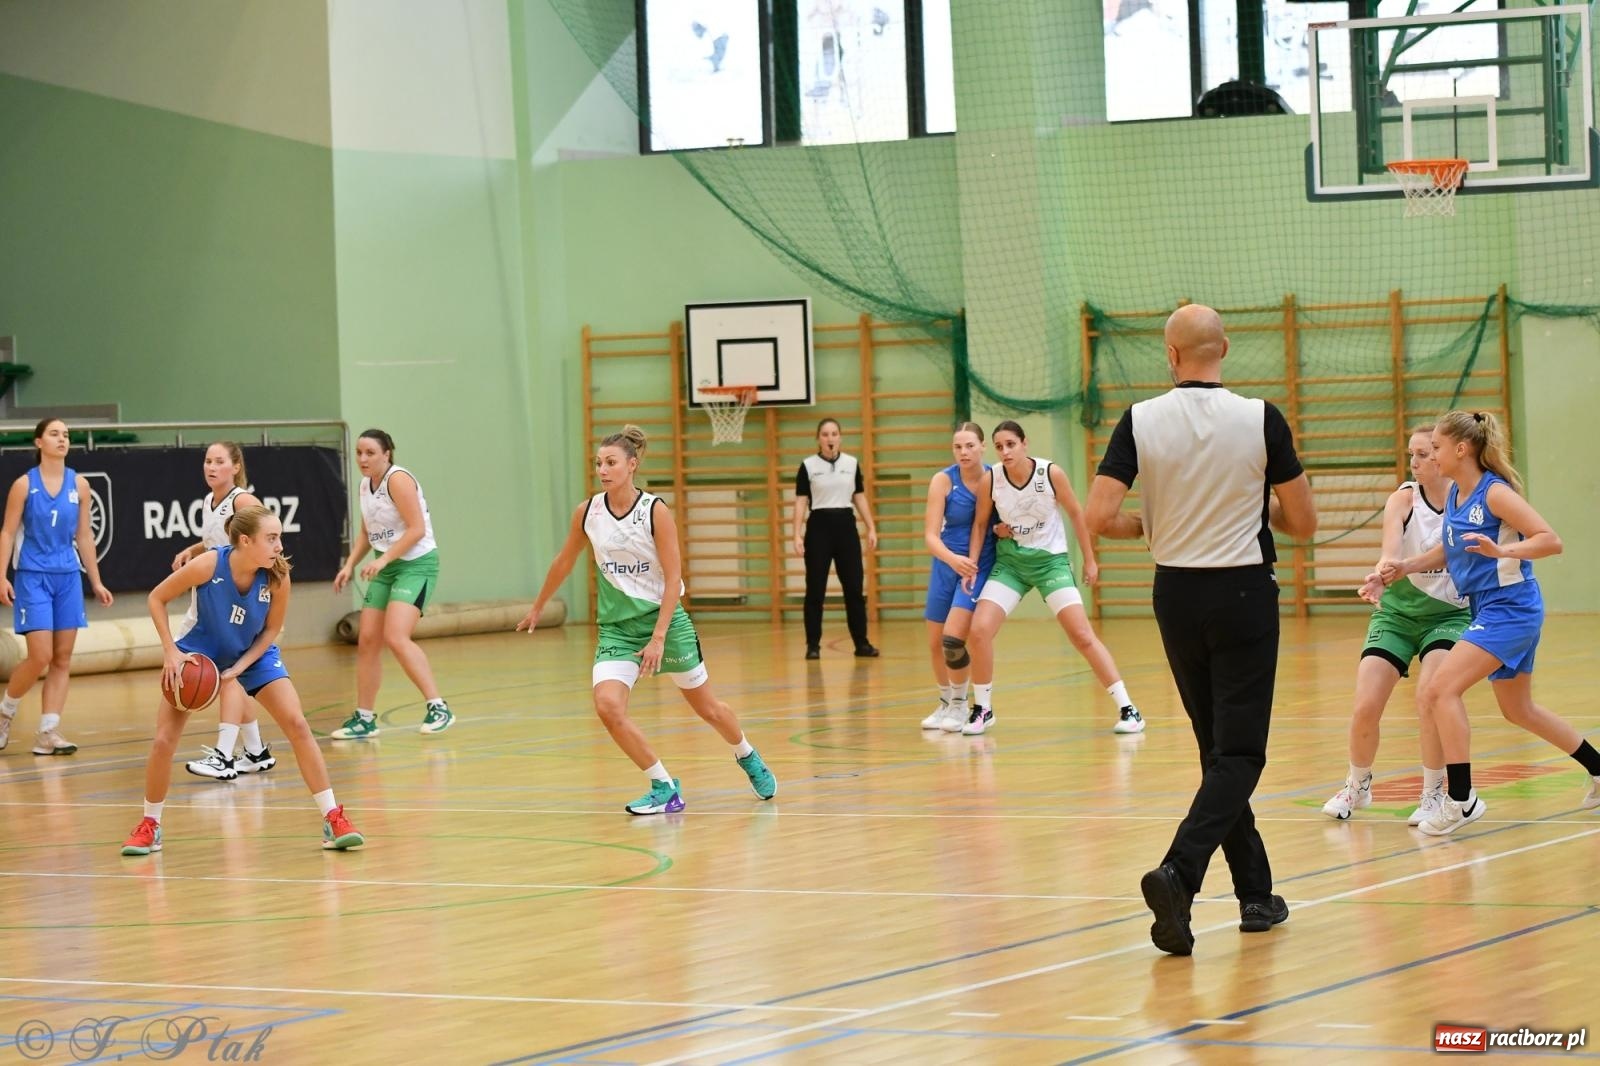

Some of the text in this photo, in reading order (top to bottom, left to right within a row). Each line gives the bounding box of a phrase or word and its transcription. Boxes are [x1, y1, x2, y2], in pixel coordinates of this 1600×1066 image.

[51, 509, 59, 527] 7
[1446, 525, 1455, 547] 3
[229, 604, 246, 625] 15
